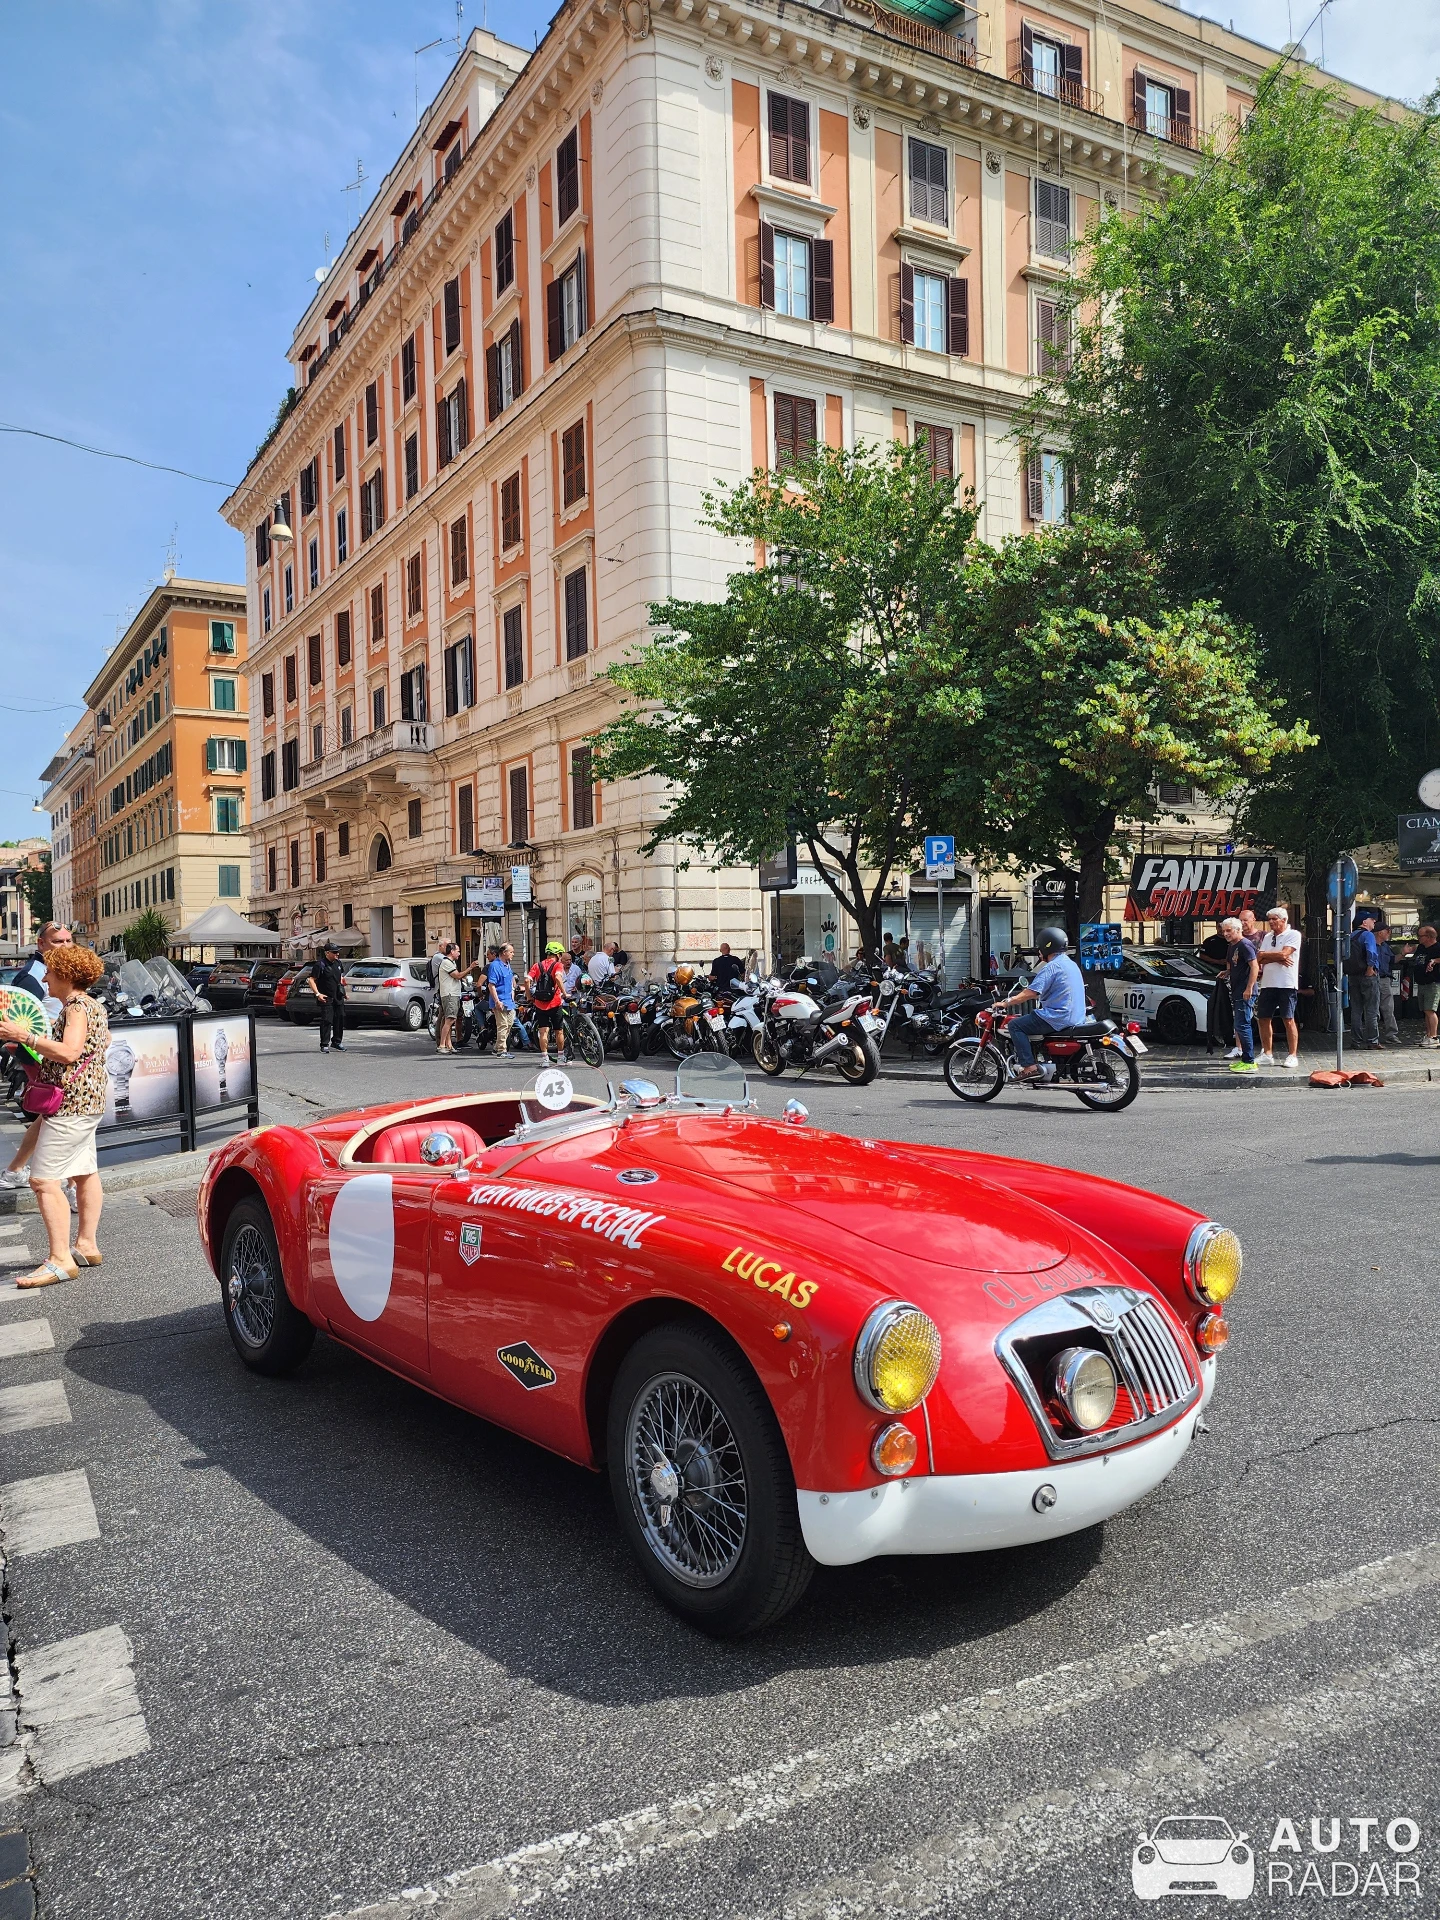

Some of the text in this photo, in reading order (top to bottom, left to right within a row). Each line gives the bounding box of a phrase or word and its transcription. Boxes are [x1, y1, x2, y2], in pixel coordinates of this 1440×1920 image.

[932, 841, 947, 861] P
[1137, 859, 1269, 891] FANTILLI
[1145, 888, 1258, 917] 500 RACE
[1124, 993, 1145, 1010] 102
[145, 1060, 170, 1069] PALMA
[195, 1059, 212, 1069] TISSOT
[543, 1080, 565, 1097] 43
[467, 1185, 667, 1249] KEN MILES SPECIAL
[721, 1246, 819, 1309] LUCAS
[982, 1277, 1034, 1309] CL
